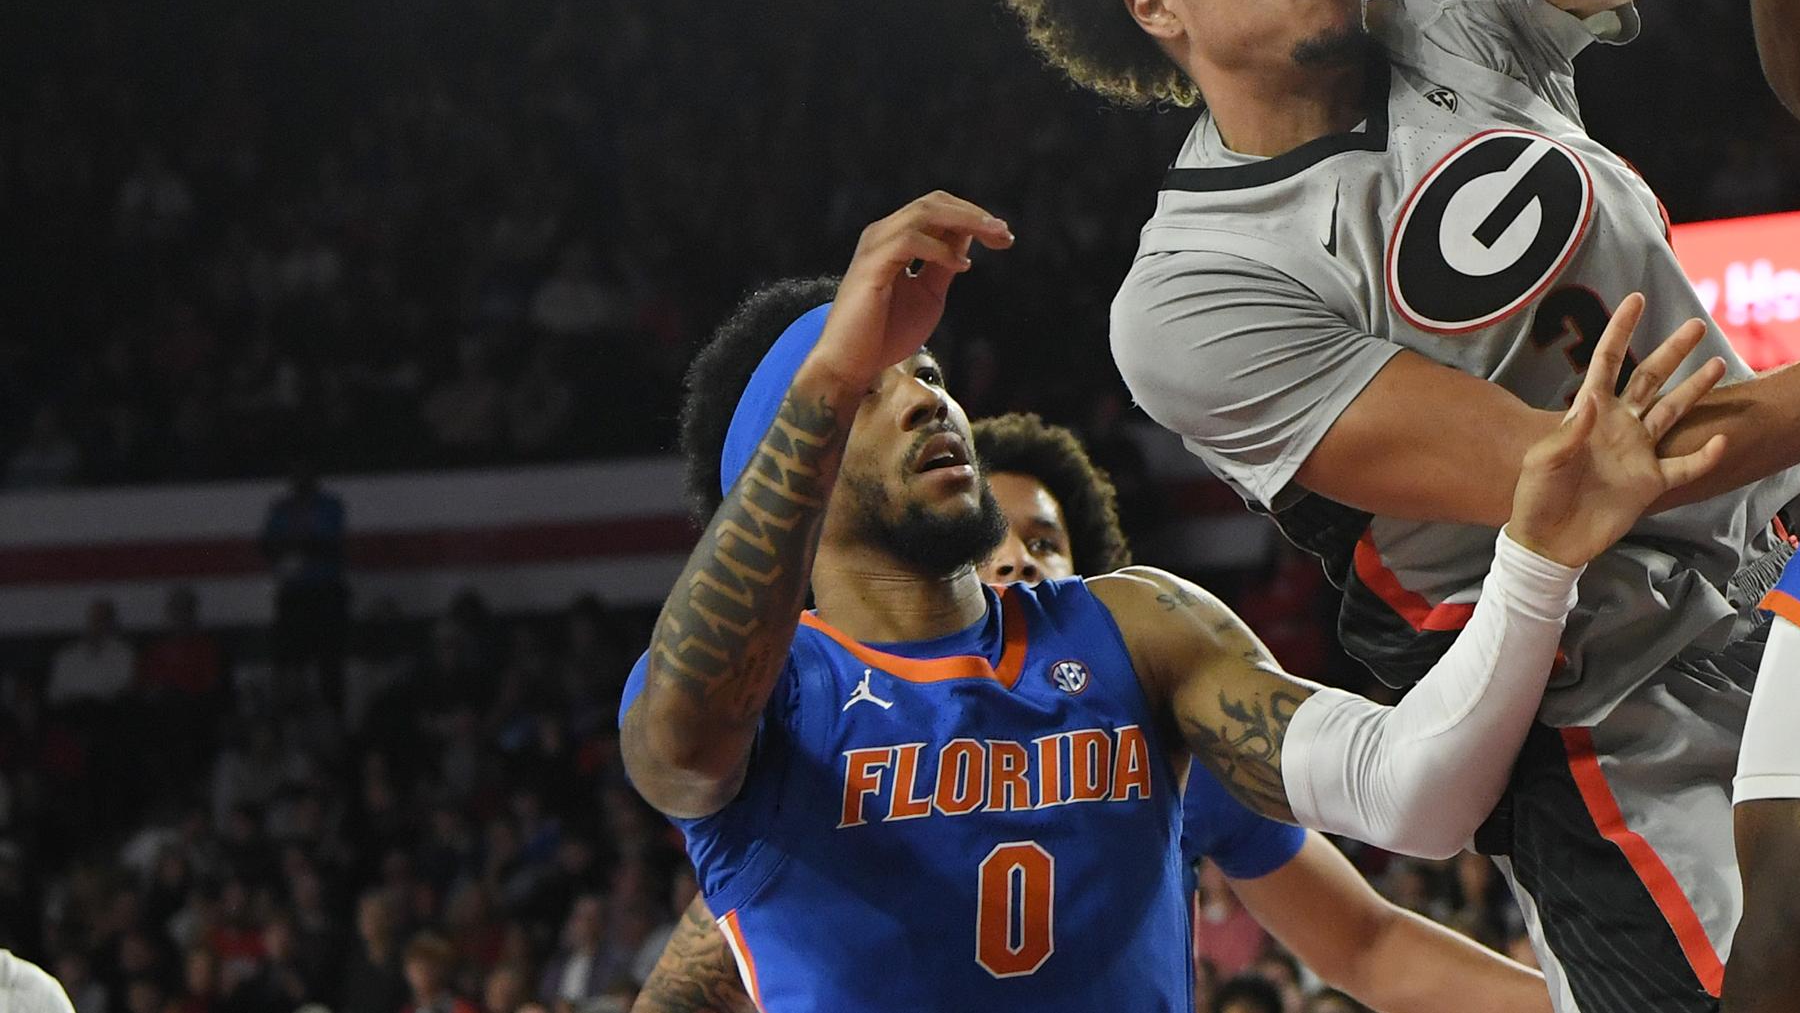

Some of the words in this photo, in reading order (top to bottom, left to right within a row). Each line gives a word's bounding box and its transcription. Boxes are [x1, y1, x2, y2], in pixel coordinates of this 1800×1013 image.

[1395, 135, 1585, 324] G
[1053, 662, 1086, 691] SEC
[836, 725, 1151, 828] FLORIDA
[975, 840, 1055, 978] 0
